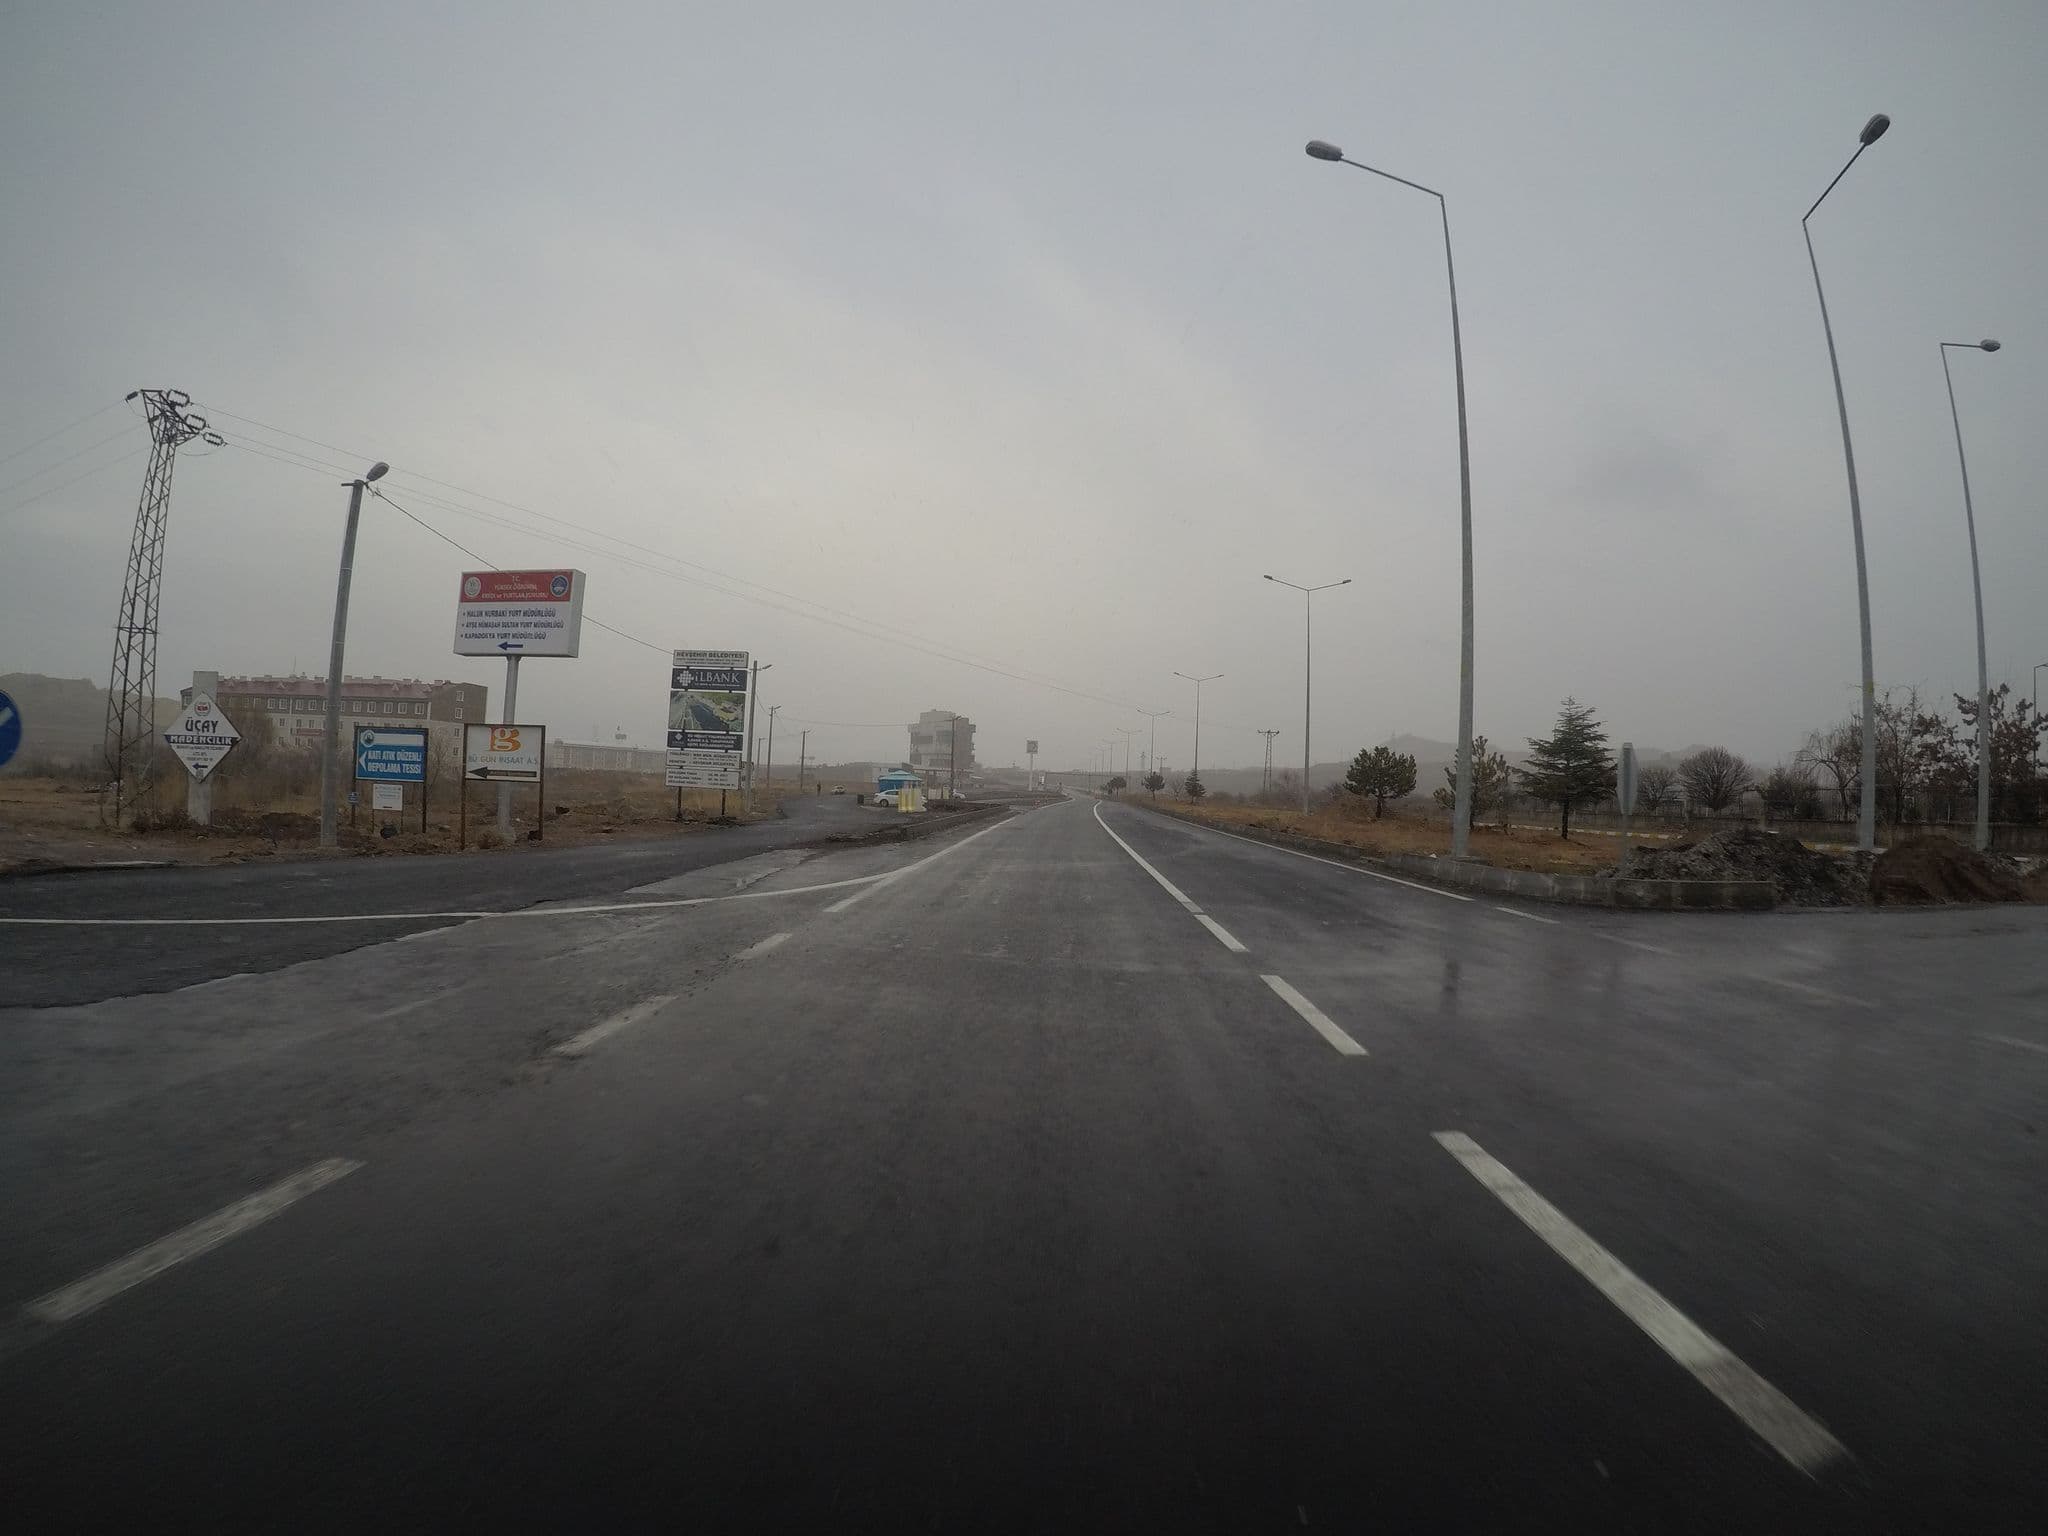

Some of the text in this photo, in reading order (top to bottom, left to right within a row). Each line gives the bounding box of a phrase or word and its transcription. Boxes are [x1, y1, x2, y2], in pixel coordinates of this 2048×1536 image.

[508, 609, 522, 617] YURT
[522, 608, 556, 618] MÜDÜRLÜĞÜ
[519, 621, 533, 629] YURT
[533, 620, 564, 629] MÜDÜRLÜĞÜ
[496, 632, 511, 640] YURT
[511, 631, 547, 640] MÜDÜRLÜĞÜ
[185, 716, 219, 735] ÜÇAY
[382, 750, 396, 761] ATIK
[367, 762, 401, 773] DEPOLAMA
